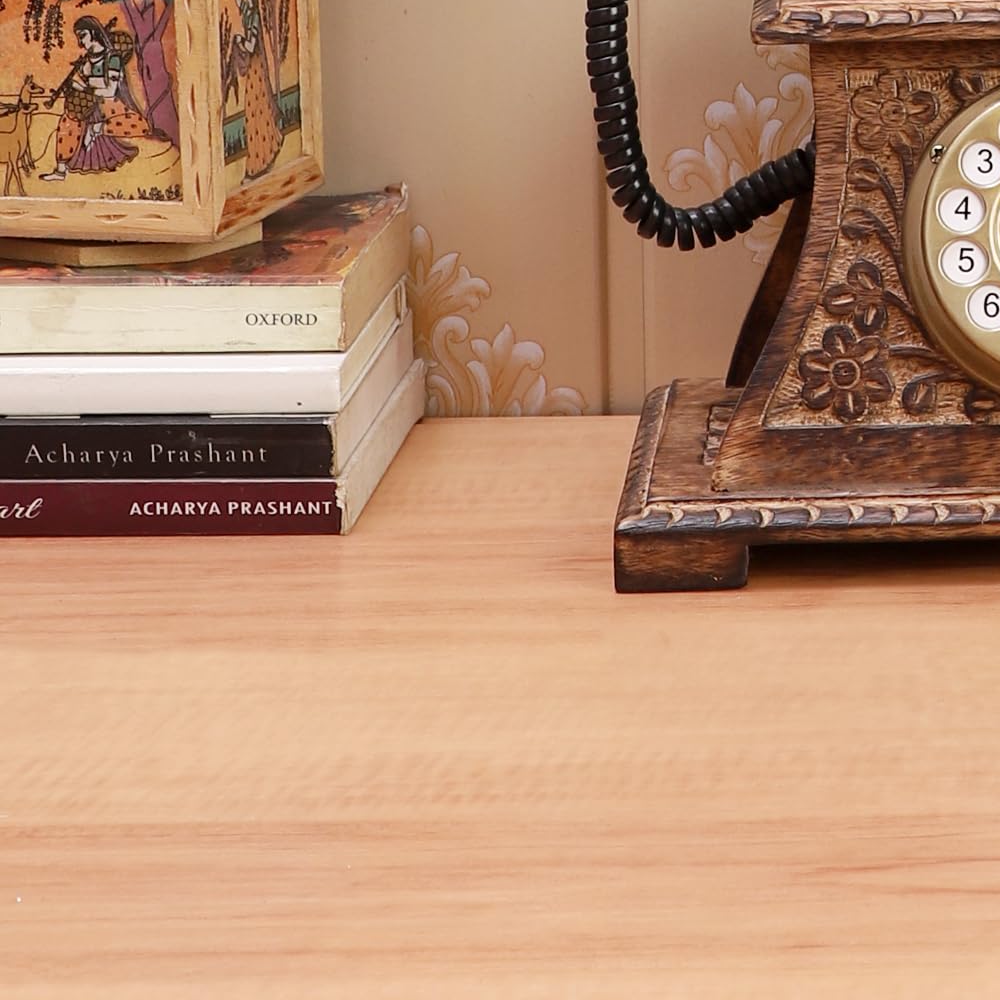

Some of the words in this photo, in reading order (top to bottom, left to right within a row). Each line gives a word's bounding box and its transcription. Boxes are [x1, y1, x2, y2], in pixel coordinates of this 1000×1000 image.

[977, 148, 993, 174] 3
[954, 196, 972, 220] 4
[958, 247, 975, 273] 5
[983, 292, 1000, 318] 6
[245, 313, 318, 326] OXFORD
[25, 443, 133, 467] Acharya
[150, 443, 268, 463] Prashant
[129, 501, 221, 516] ACHARYA
[228, 501, 332, 515] PRASHANT
